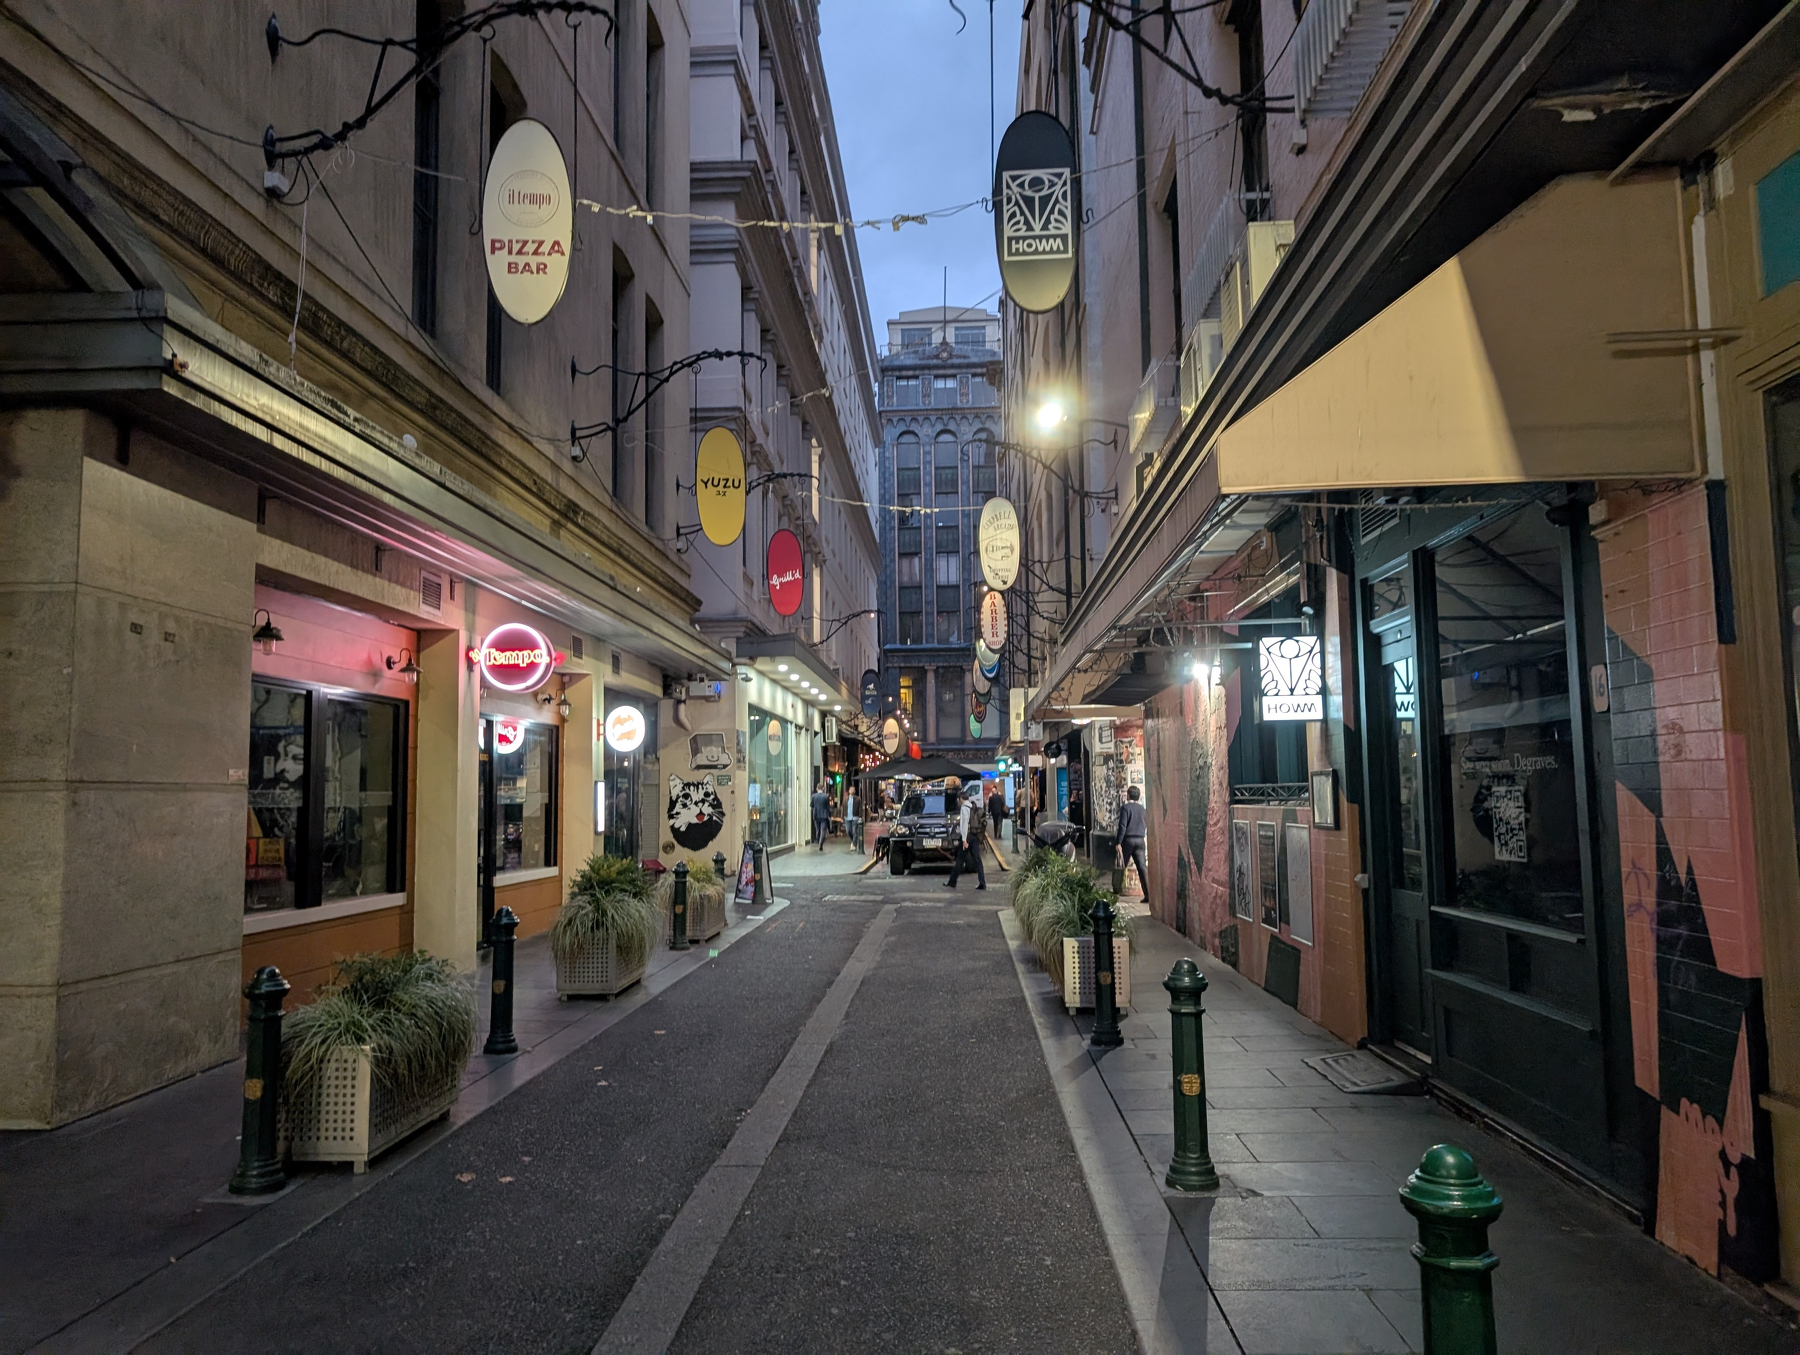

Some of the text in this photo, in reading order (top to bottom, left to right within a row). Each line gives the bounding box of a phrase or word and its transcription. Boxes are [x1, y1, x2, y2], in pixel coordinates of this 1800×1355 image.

[508, 189, 551, 210] il tempo
[490, 238, 566, 256] PIZZA
[507, 262, 548, 275] BAR
[701, 476, 741, 490] YUZU
[770, 568, 802, 590] Grill'd
[988, 592, 1000, 639] BARBER
[988, 640, 1003, 648] SHOP
[1595, 673, 1606, 699] 16
[1514, 753, 1559, 776] Degraves.
